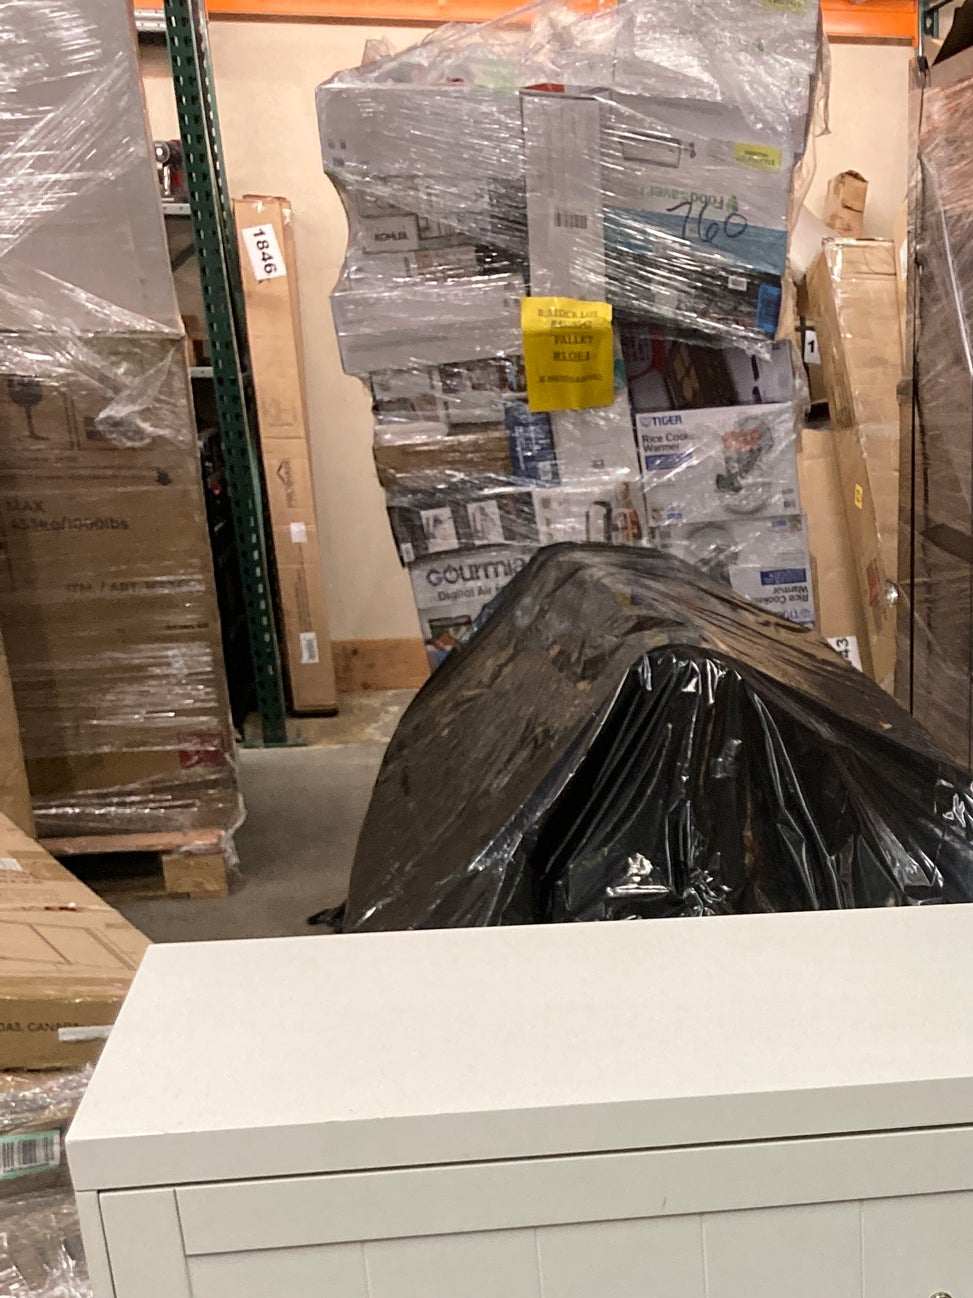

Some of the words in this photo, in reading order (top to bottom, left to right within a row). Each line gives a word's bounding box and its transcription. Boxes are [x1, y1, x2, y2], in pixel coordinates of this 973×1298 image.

[666, 200, 748, 243] 760
[253, 228, 277, 274] 1846
[652, 415, 683, 426] TIGER
[642, 434, 664, 443] Rice
